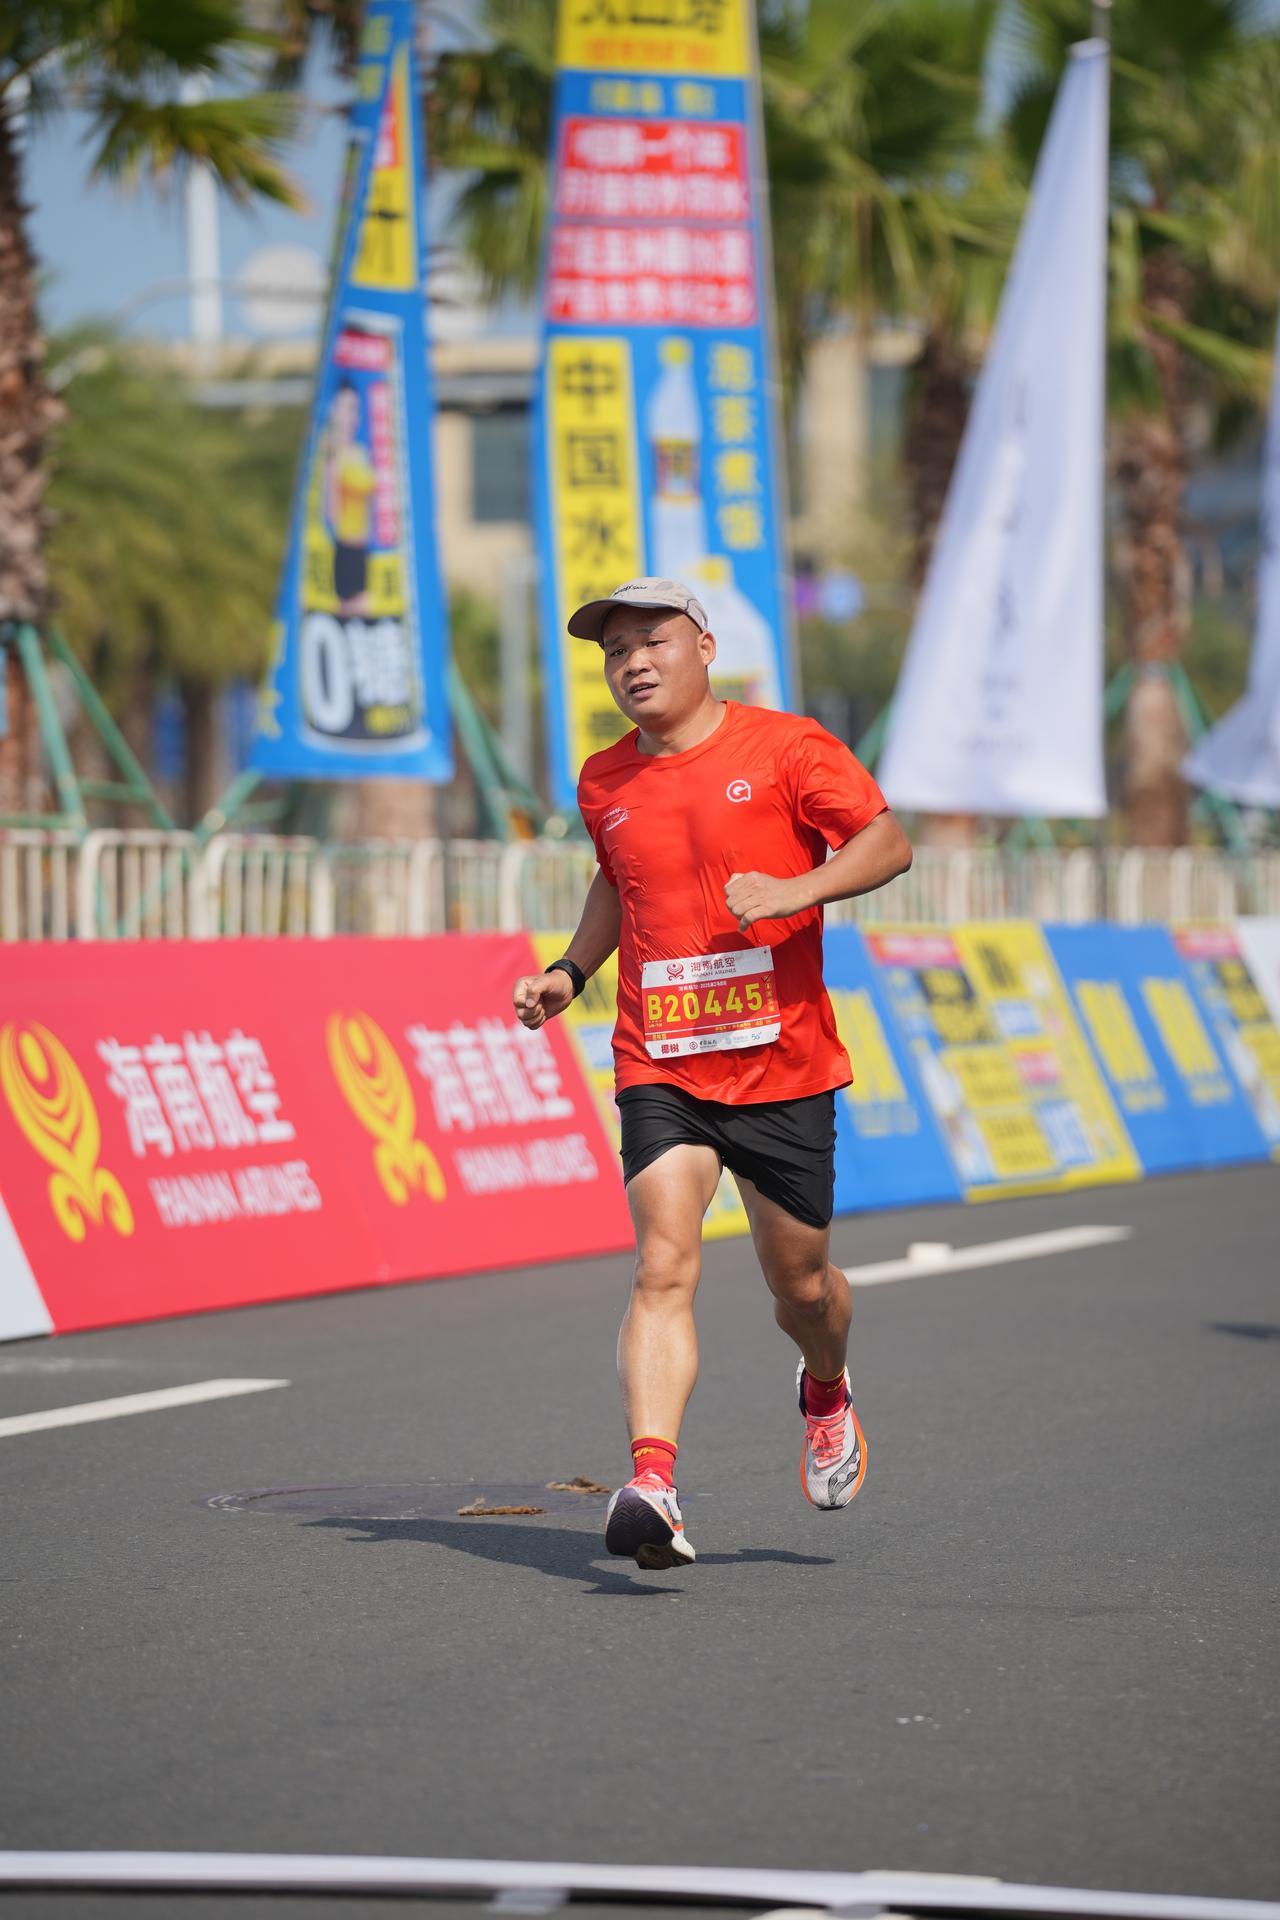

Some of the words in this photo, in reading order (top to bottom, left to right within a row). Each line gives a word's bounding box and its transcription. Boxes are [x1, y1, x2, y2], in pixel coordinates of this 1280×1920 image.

[690, 957, 736, 972] 海南航空
[714, 967, 737, 976] AIRLINES
[647, 983, 762, 1022] B20445
[96, 1028, 297, 1157] 海南航空
[405, 1016, 576, 1133] 海南航空
[148, 1169, 242, 1229] HAINAN
[233, 1158, 322, 1214] AIRLINES
[455, 1143, 534, 1195] HAINAN
